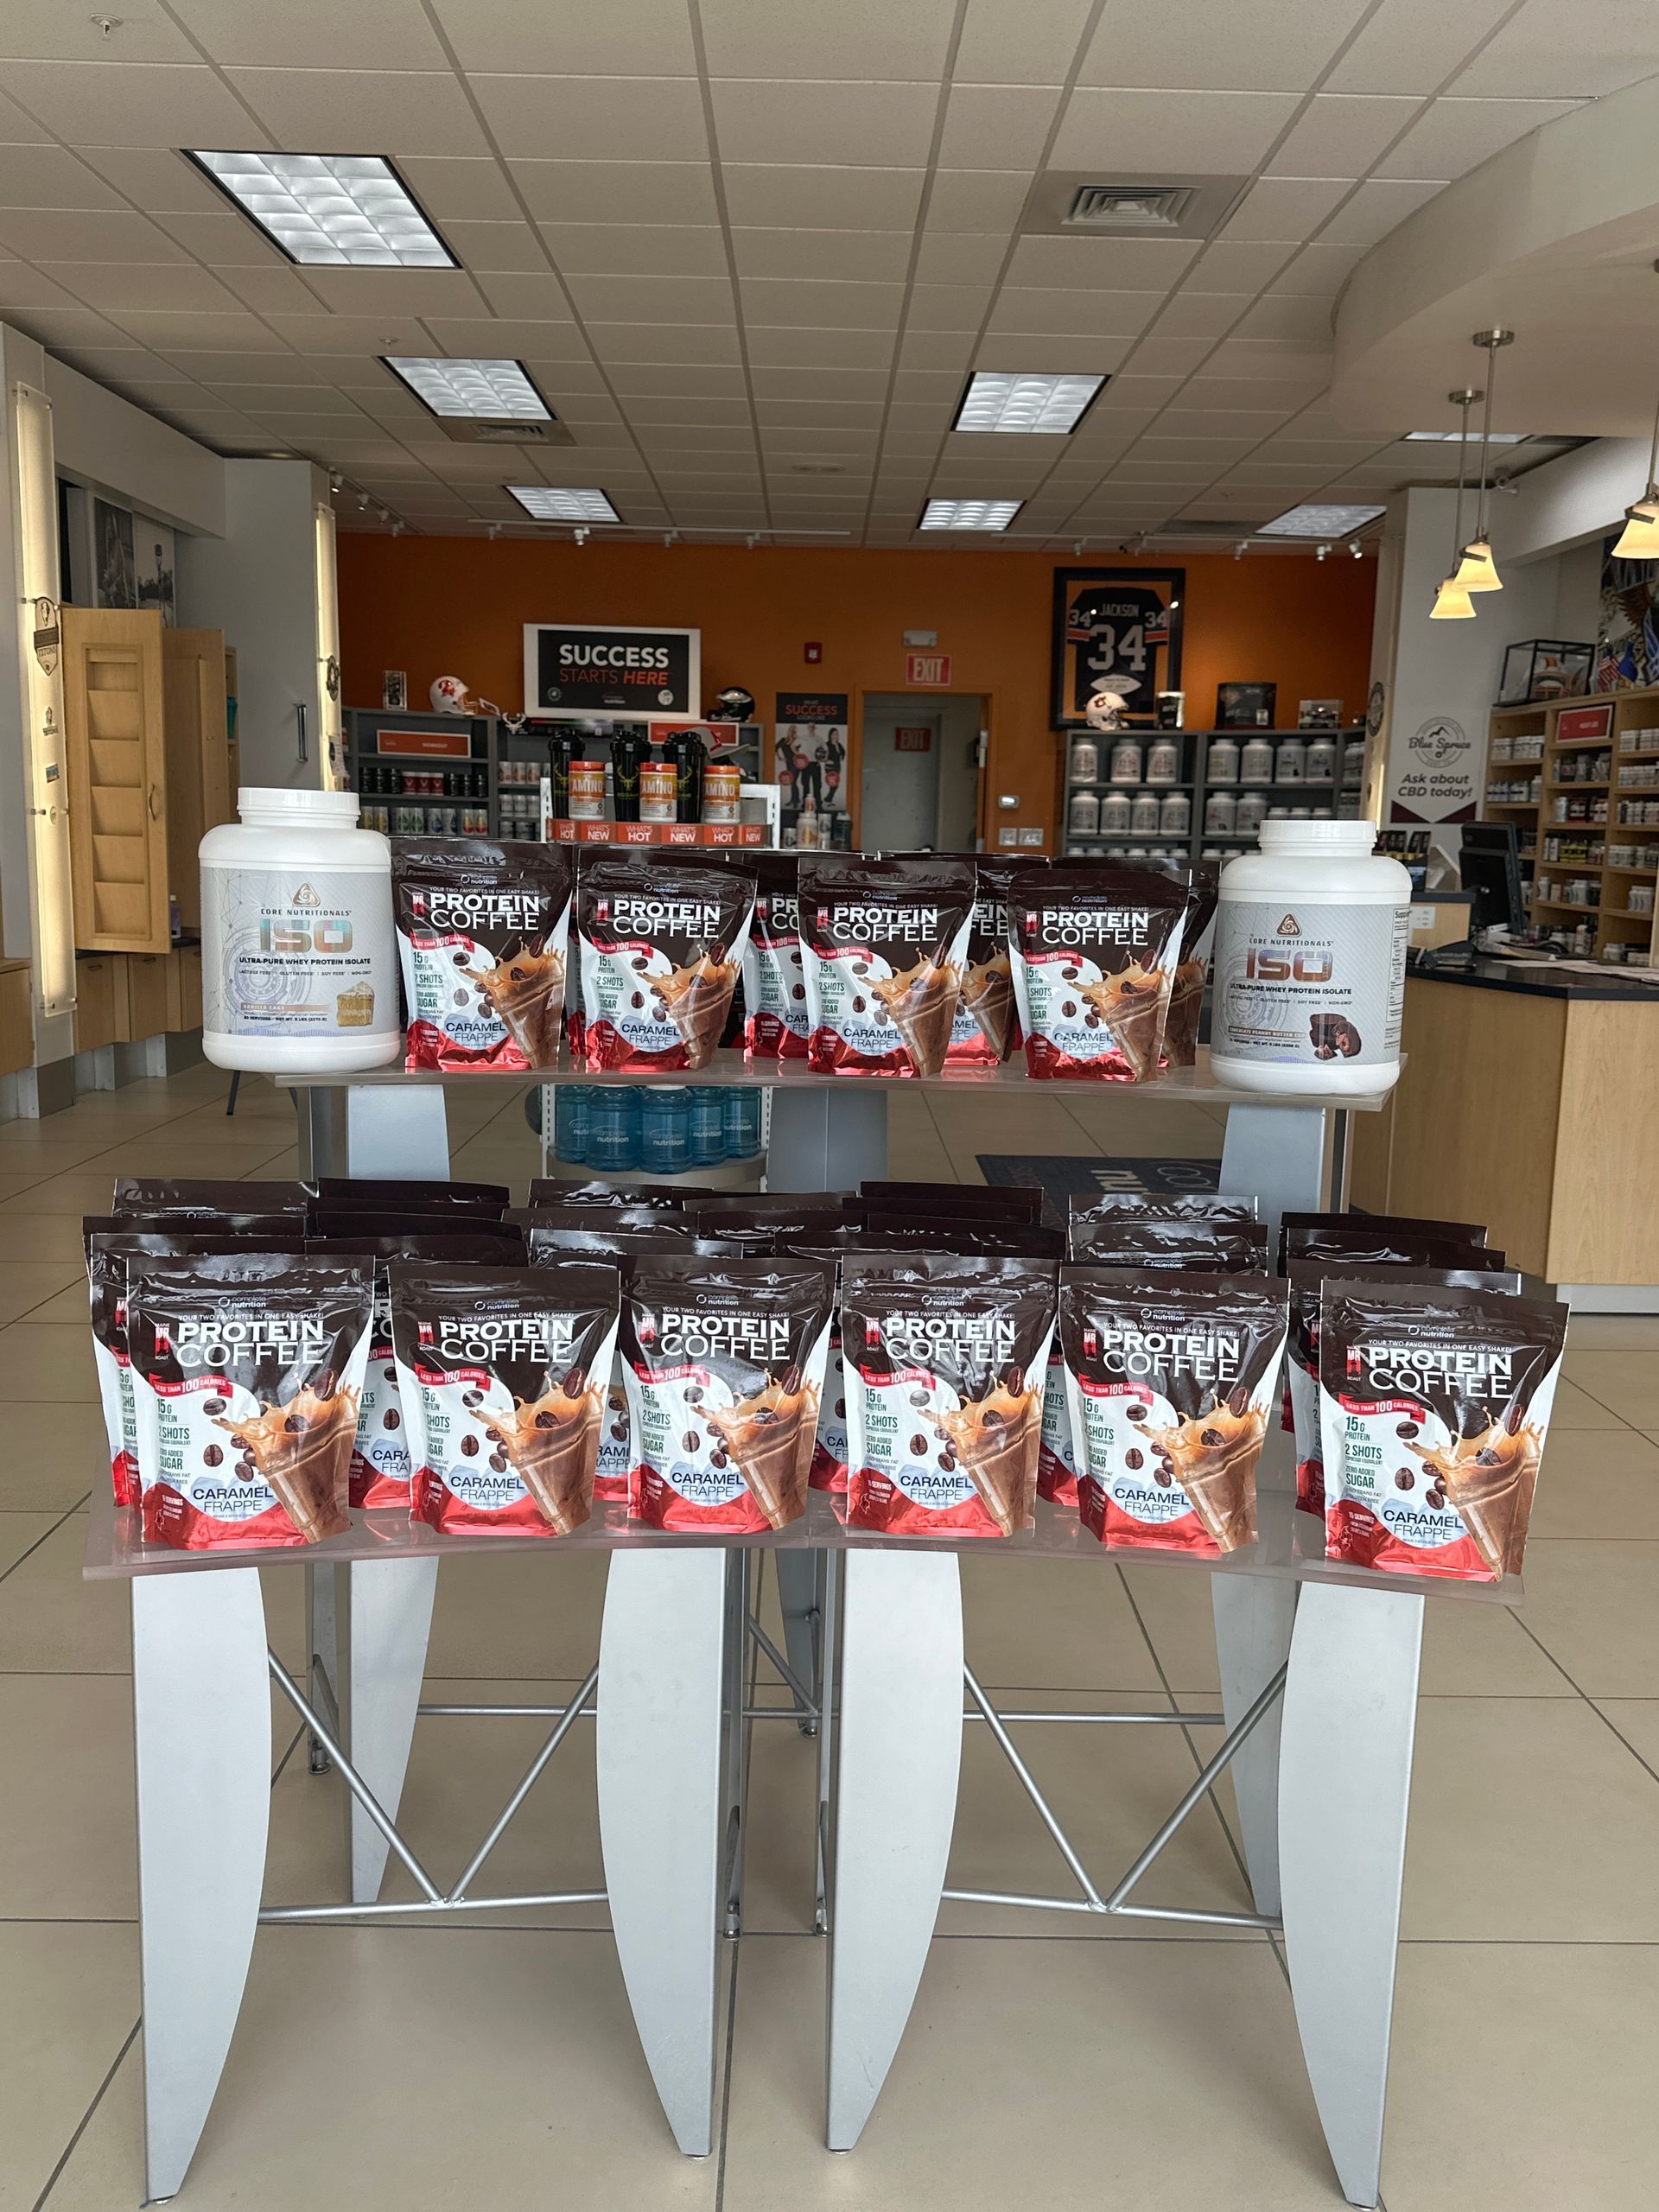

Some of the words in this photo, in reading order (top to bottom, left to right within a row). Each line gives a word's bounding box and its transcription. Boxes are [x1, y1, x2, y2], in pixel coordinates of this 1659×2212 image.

[1099, 604, 1139, 616] JACKSON
[1070, 610, 1090, 626] 34
[1145, 611, 1166, 627] 34
[1088, 625, 1147, 671] 34
[559, 645, 669, 668] SUCCESS
[560, 668, 618, 684] STARTS
[623, 671, 668, 685] HERE
[913, 658, 944, 682] EXIT
[785, 705, 837, 715] SUCCESS
[899, 730, 924, 749] EXIT
[1408, 737, 1433, 748] Blue
[1435, 738, 1471, 753] Spruce
[572, 779, 603, 792] AMINO
[1402, 774, 1427, 784] Ask
[1430, 773, 1469, 784] about
[642, 780, 672, 795] AMINO
[705, 781, 734, 796] AMINO
[1398, 787, 1427, 796] CBD
[1431, 787, 1472, 799] today!
[562, 830, 574, 839] HOT
[588, 831, 609, 841] NEW
[628, 832, 651, 842] HOT
[671, 833, 696, 842] NEW
[714, 833, 734, 842] HOT
[746, 833, 760, 842] NEW
[430, 893, 539, 912] PROTEIN
[613, 899, 721, 921] PROTEIN
[834, 906, 938, 924] PROTEIN
[430, 911, 539, 931] COFFEE
[1042, 912, 1149, 927] PROTEIN
[613, 916, 719, 938] COFFEE
[833, 923, 938, 942] COFFEE
[260, 918, 353, 953] ISO
[1042, 927, 1148, 945] COFFEE
[1246, 948, 1333, 982] ISO
[419, 975, 443, 984] SHOTS
[602, 976, 624, 987] SHOTS
[823, 982, 844, 992] SHOTS
[1030, 987, 1052, 997] SHOTS
[1230, 983, 1264, 992] ULTRA-PURE
[446, 1022, 505, 1032] CARAMEL
[622, 1023, 680, 1036] CARAMEL
[843, 1027, 900, 1039] CARAMEL
[454, 1033, 499, 1041] FRAPPE
[629, 1034, 671, 1046] FRAPPE
[851, 1038, 893, 1048] FRAPPE
[1054, 1033, 1113, 1042] CARAMEL
[1063, 1042, 1104, 1051] FRAPPE
[177, 1320, 324, 1344] PROTEIN
[439, 1319, 575, 1340] PROTEIN
[662, 1313, 790, 1338] PROTEIN
[887, 1317, 1015, 1340] PROTEIN
[440, 1338, 572, 1363] COFFEE
[660, 1333, 791, 1360] COFFEE
[885, 1338, 1015, 1363] COFFEE
[1103, 1330, 1240, 1359] PROTEIN
[176, 1341, 323, 1367] COFFEE
[1369, 1346, 1512, 1375] PROTEIN
[1103, 1350, 1239, 1382] COFFEE
[444, 1371, 461, 1382] 100
[664, 1368, 680, 1379] 100
[891, 1371, 906, 1382] 100
[181, 1381, 200, 1392] 100
[1109, 1383, 1123, 1395] 100
[1369, 1369, 1512, 1399] COFFEE
[639, 1385, 650, 1399] 15
[865, 1388, 875, 1402] 15
[157, 1399, 166, 1414] 15
[866, 1402, 887, 1412] PROTEIN
[1346, 1402, 1359, 1411] LESS
[1376, 1401, 1392, 1413] 100
[1393, 1402, 1418, 1411] CALORIES
[427, 1414, 450, 1428] SHOTS
[647, 1414, 671, 1426] SHOTS
[866, 1414, 870, 1425] 2
[872, 1415, 898, 1428] SHOTS
[1346, 1416, 1358, 1431] 15
[162, 1427, 189, 1440] SHOTS
[1088, 1427, 1115, 1440] SHOTS
[1345, 1432, 1370, 1441] PROTEIN
[643, 1440, 664, 1453] SUGAR
[867, 1442, 892, 1457] SUGAR
[1345, 1444, 1350, 1455] 2
[1352, 1446, 1382, 1459] SHOTS
[159, 1456, 183, 1469] SUGAR
[450, 1476, 525, 1489] CARAMEL
[671, 1471, 744, 1485] CARAMEL
[900, 1475, 973, 1489] CARAMEL
[1345, 1473, 1375, 1488] SUGAR
[193, 1487, 274, 1500] CARAMEL
[460, 1489, 514, 1501] FRAPPE
[681, 1485, 734, 1497] FRAPPE
[910, 1489, 963, 1501] FRAPPE
[1115, 1487, 1190, 1505] CARAMEL
[203, 1500, 263, 1513] FRAPPE
[1124, 1502, 1179, 1516] FRAPPE
[1383, 1510, 1464, 1529] CARAMEL
[1394, 1523, 1452, 1541] FRAPPE
